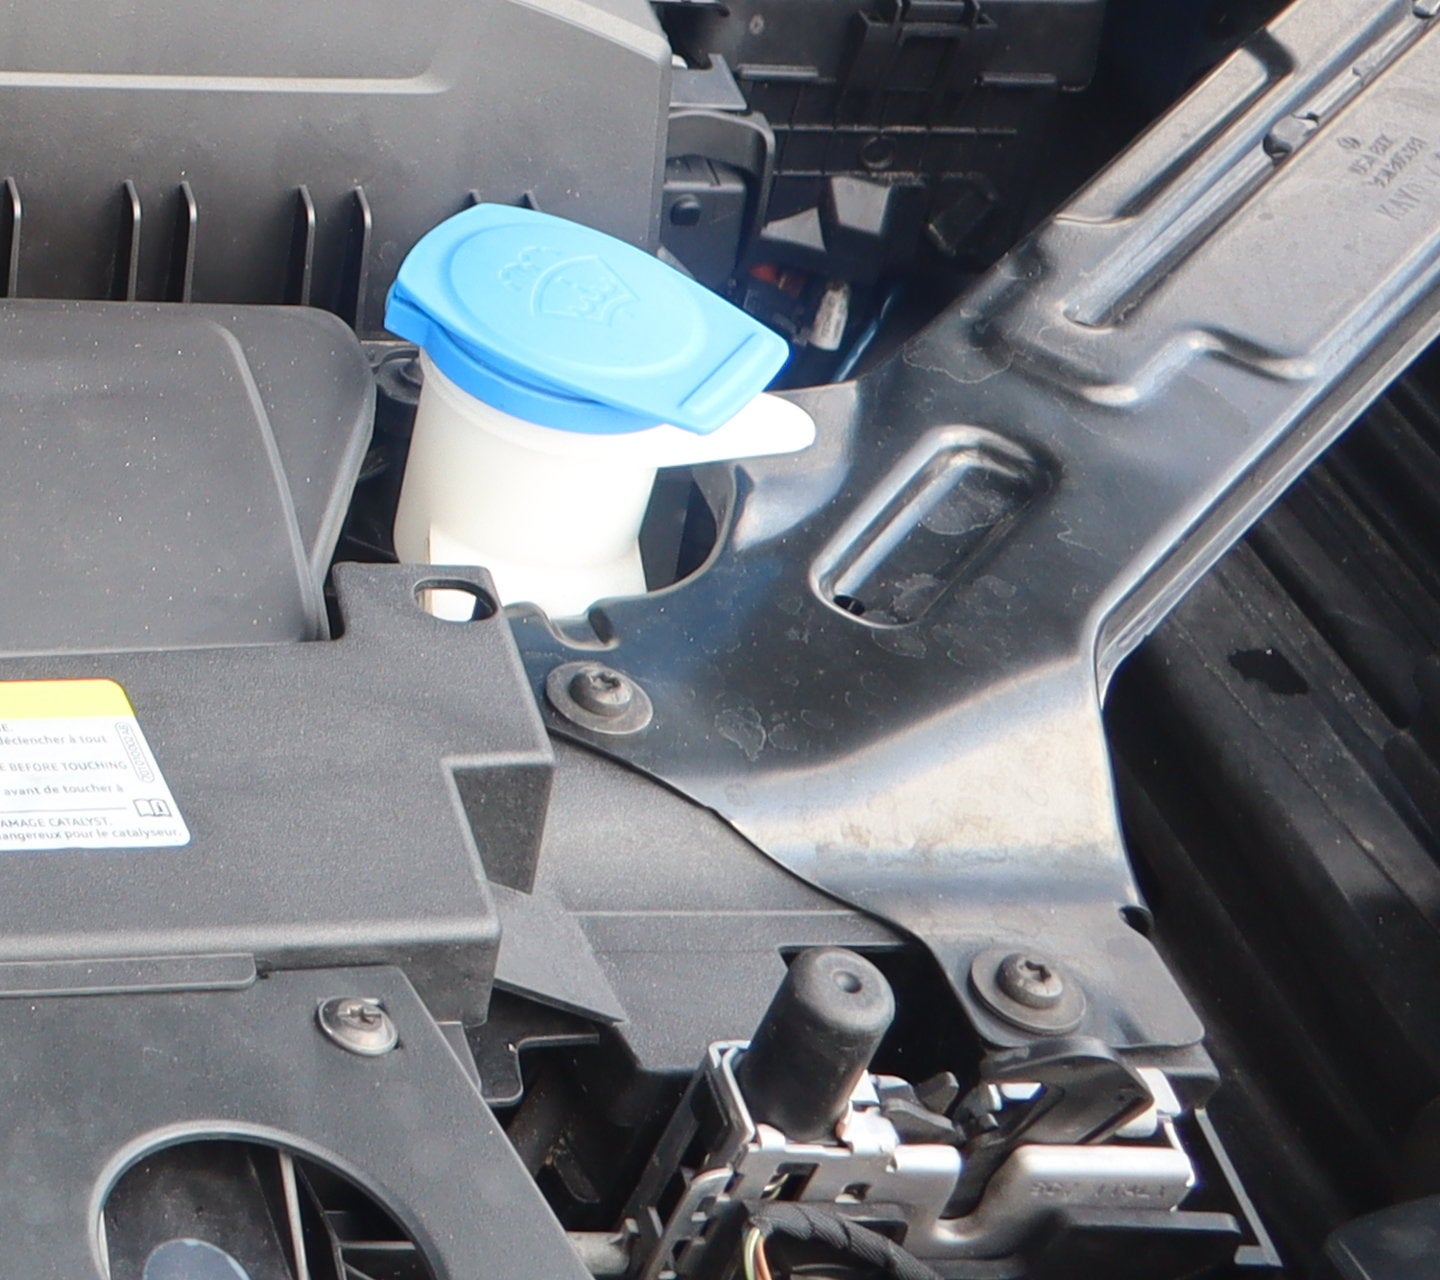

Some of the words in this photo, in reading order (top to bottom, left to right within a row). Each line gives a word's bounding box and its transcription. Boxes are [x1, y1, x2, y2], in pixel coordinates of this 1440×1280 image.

[80, 735, 107, 743] tout
[10, 762, 58, 771] BEFORE
[61, 761, 128, 770] TOUCHING
[4, 787, 40, 795] avant
[44, 785, 59, 794] de
[64, 785, 112, 794] toucher
[64, 830, 92, 841] pour
